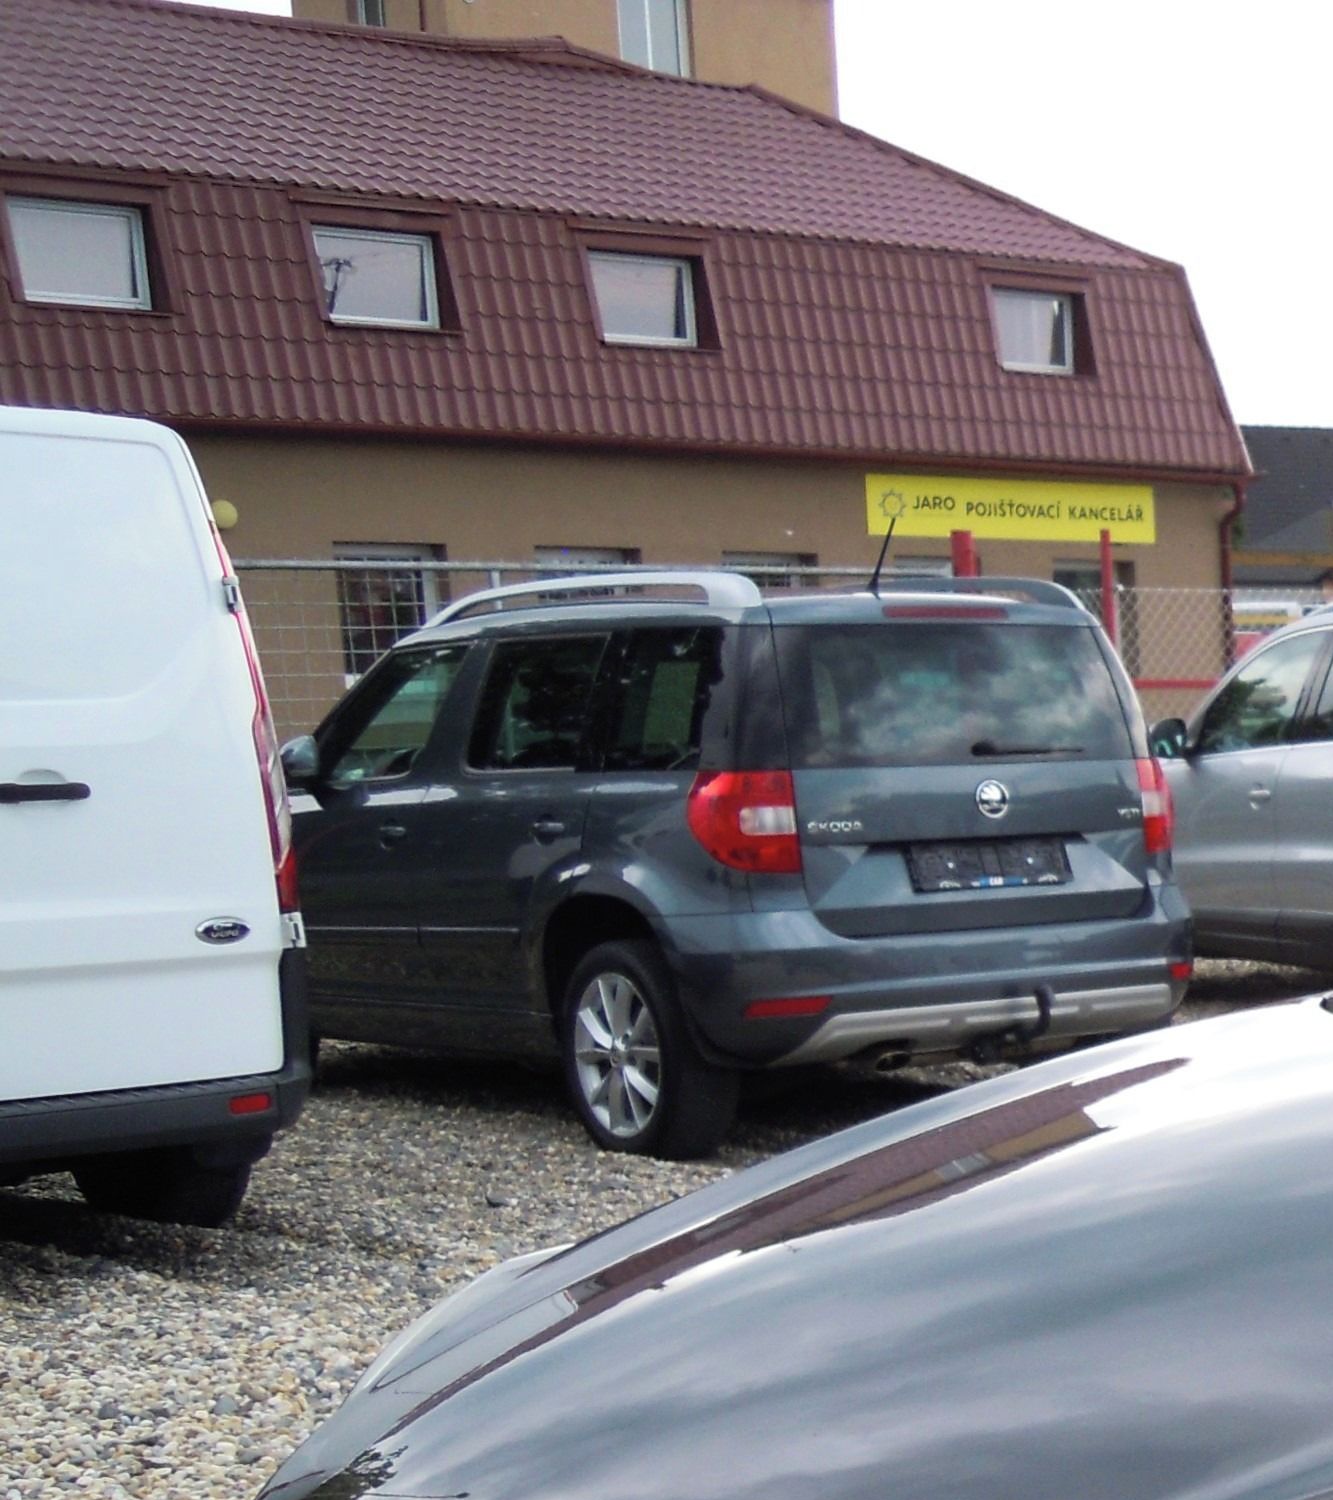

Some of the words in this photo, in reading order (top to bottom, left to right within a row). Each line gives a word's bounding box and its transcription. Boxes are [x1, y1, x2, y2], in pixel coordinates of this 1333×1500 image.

[912, 495, 956, 511] JARO
[965, 499, 1061, 520] POJIŠŤOVACÍ
[1067, 502, 1144, 522] KANCELÁŘ
